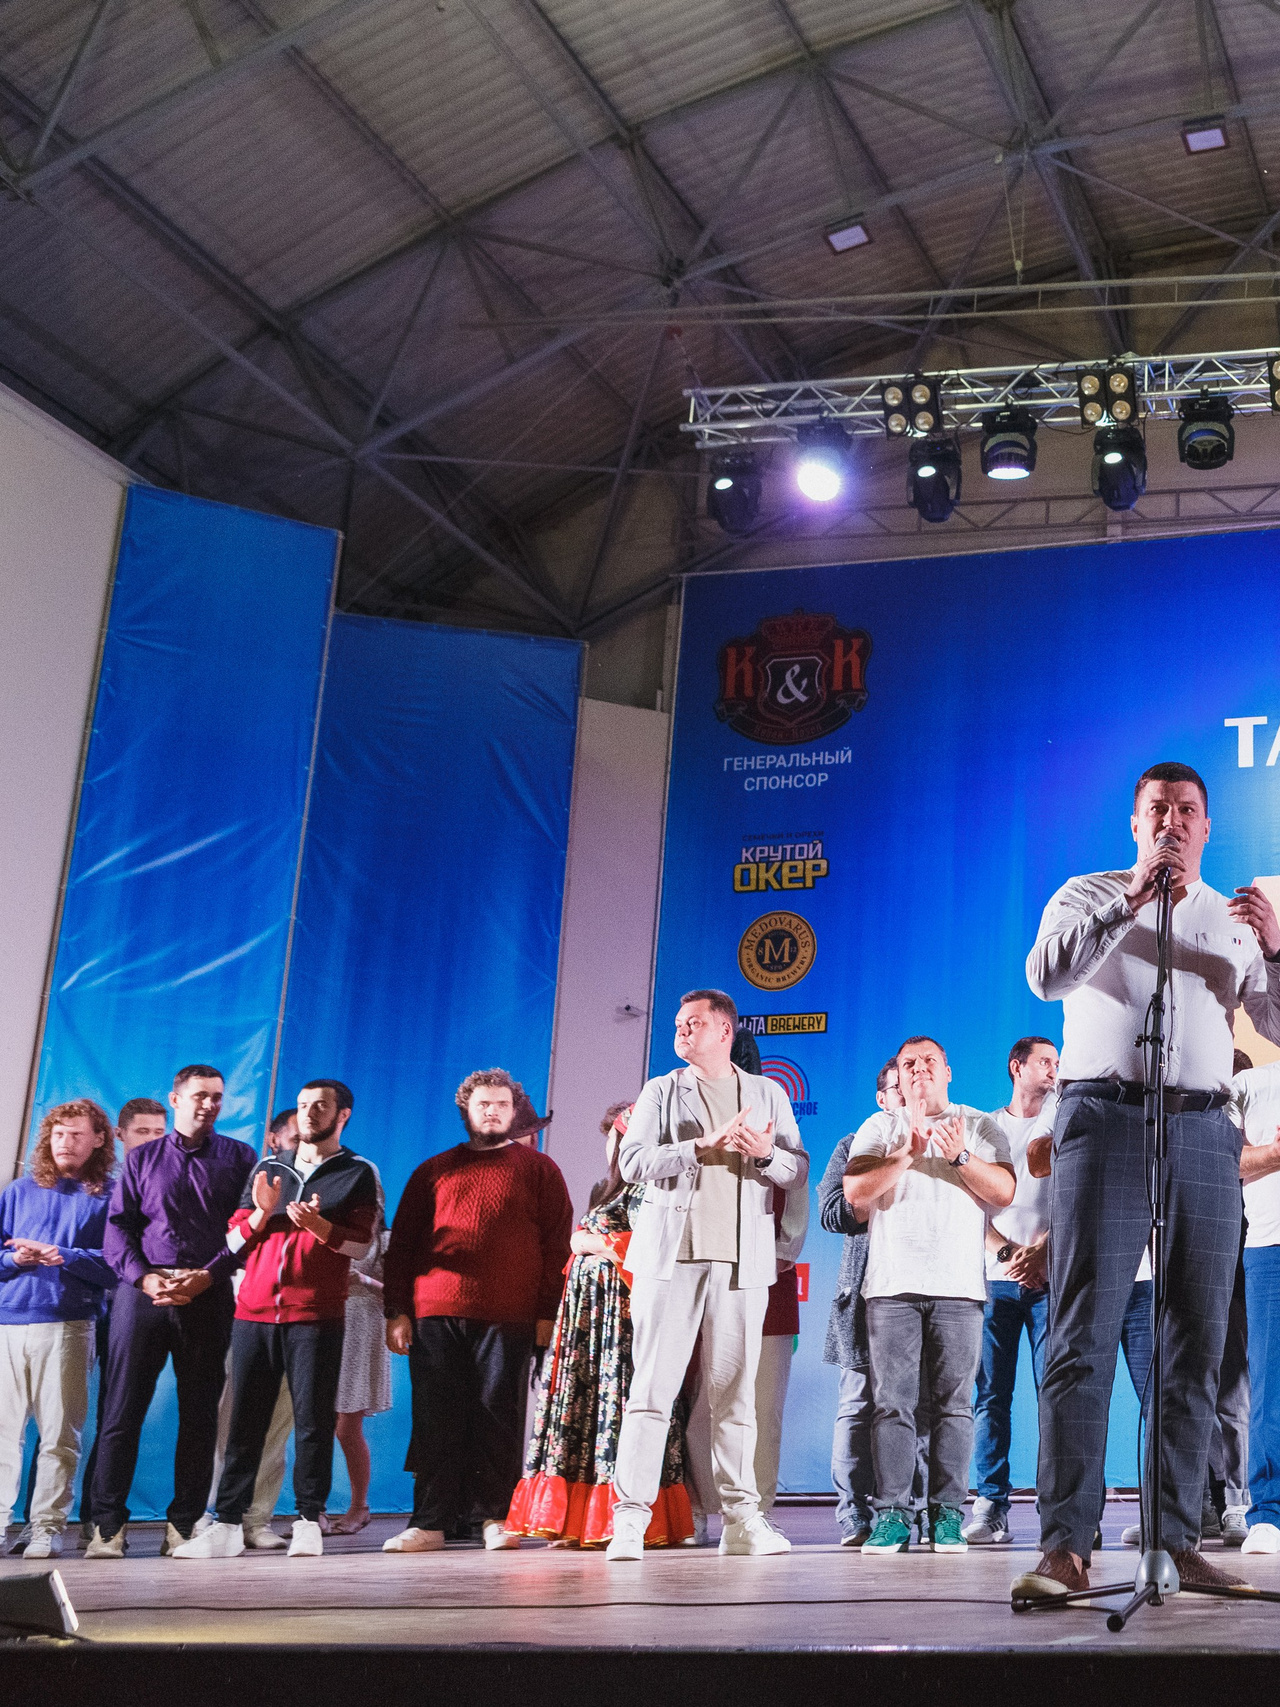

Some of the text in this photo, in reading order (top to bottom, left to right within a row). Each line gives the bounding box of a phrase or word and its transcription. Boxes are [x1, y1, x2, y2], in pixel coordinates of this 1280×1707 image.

[723, 746, 852, 771] ГЕНЕРАЛЬНЫЙ
[743, 772, 828, 791] СПОНСОР
[741, 840, 822, 862] КРУТОЙ
[744, 916, 811, 951] MEDOVARUS
[762, 937, 793, 964] M
[776, 955, 807, 983] BREWERY
[770, 1015, 823, 1032] BREWERY
[790, 1102, 818, 1116] СКОЕ
